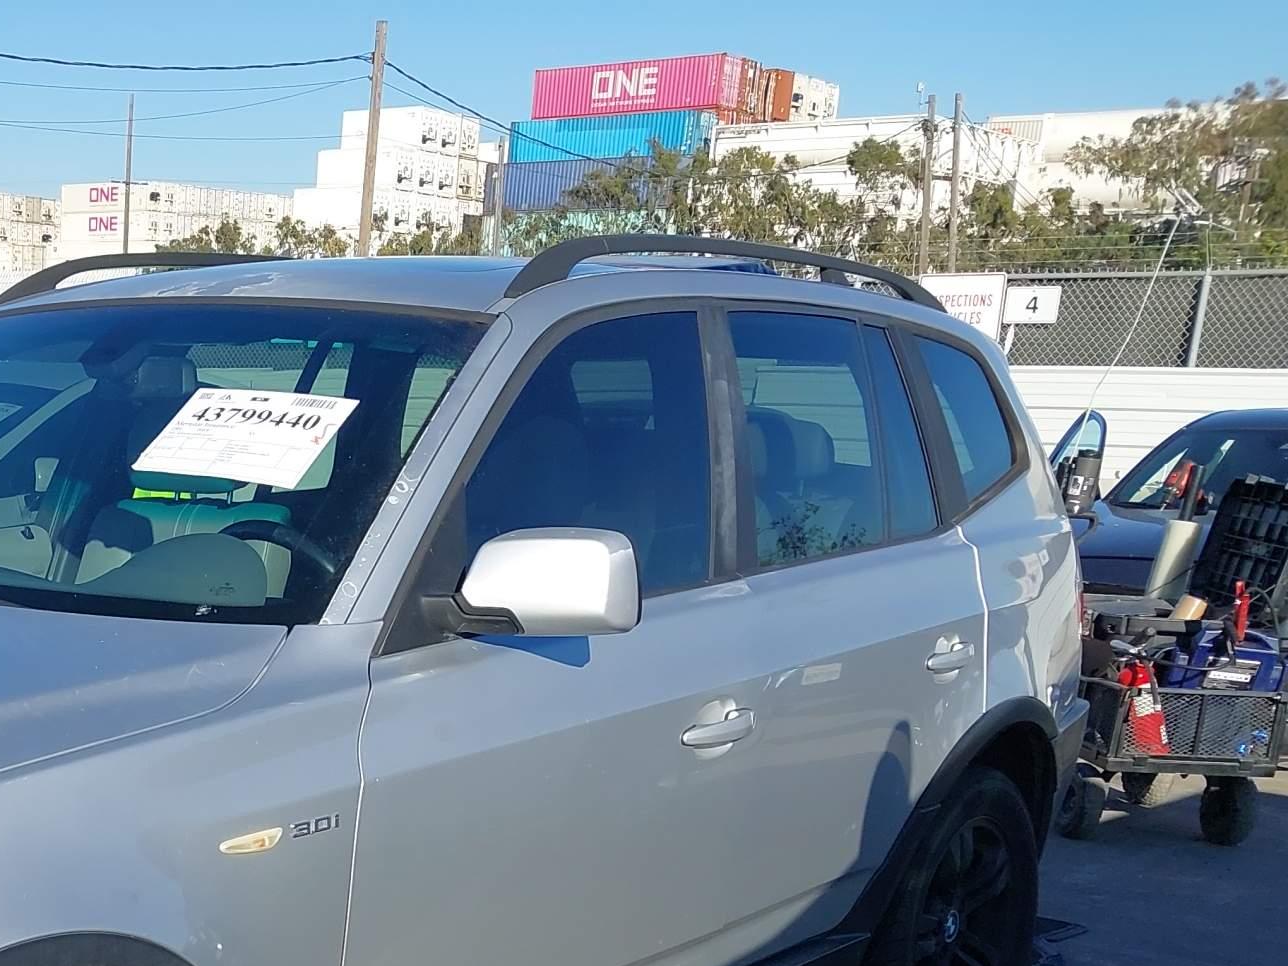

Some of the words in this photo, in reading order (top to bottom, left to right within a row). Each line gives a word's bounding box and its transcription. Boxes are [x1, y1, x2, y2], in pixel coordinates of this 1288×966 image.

[592, 67, 658, 99] ONE
[89, 187, 119, 203] ONE
[88, 216, 118, 232] ONE
[937, 293, 993, 307] SPECTIONS
[1025, 296, 1039, 314] 4
[191, 406, 322, 431] 43799440
